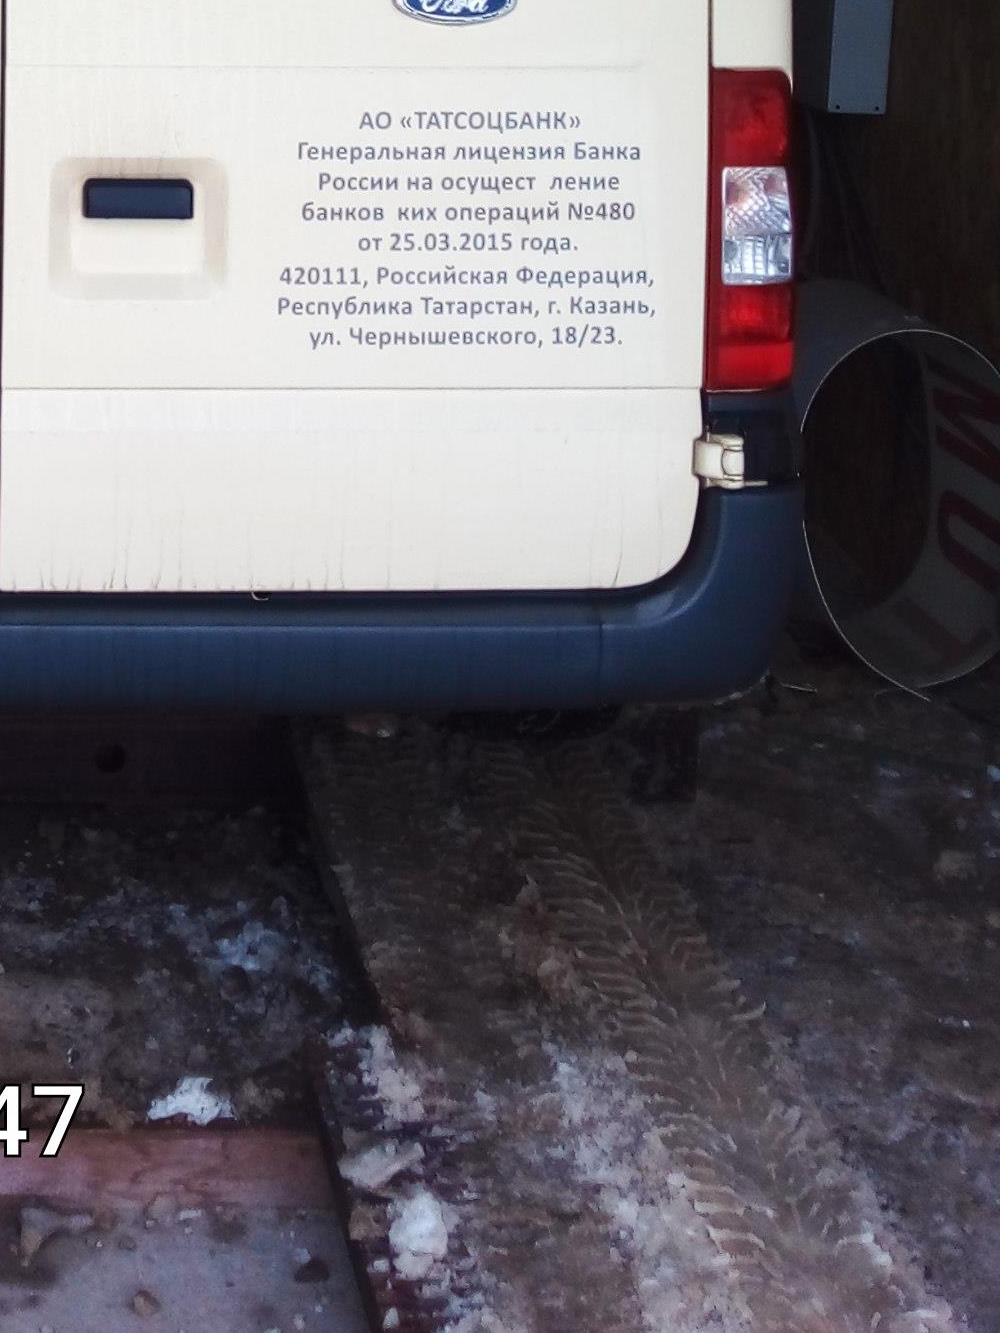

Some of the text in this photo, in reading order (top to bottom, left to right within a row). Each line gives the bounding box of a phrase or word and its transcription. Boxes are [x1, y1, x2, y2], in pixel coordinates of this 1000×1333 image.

[358, 111, 581, 135] АО «ТАТСОЦБАНК»
[297, 141, 641, 165] Генеральная лицензия Банка
[318, 172, 399, 191] России
[406, 176, 433, 191] на
[444, 201, 560, 226] операций
[567, 202, 636, 221] №480
[357, 232, 579, 255] от 25.03.2015 года.
[279, 266, 654, 289] 420111, Российская Федерация,
[277, 296, 656, 320] Республика Татарстан, г. Казань,
[309, 324, 623, 351] ул. Чернышевского, 18/23.
